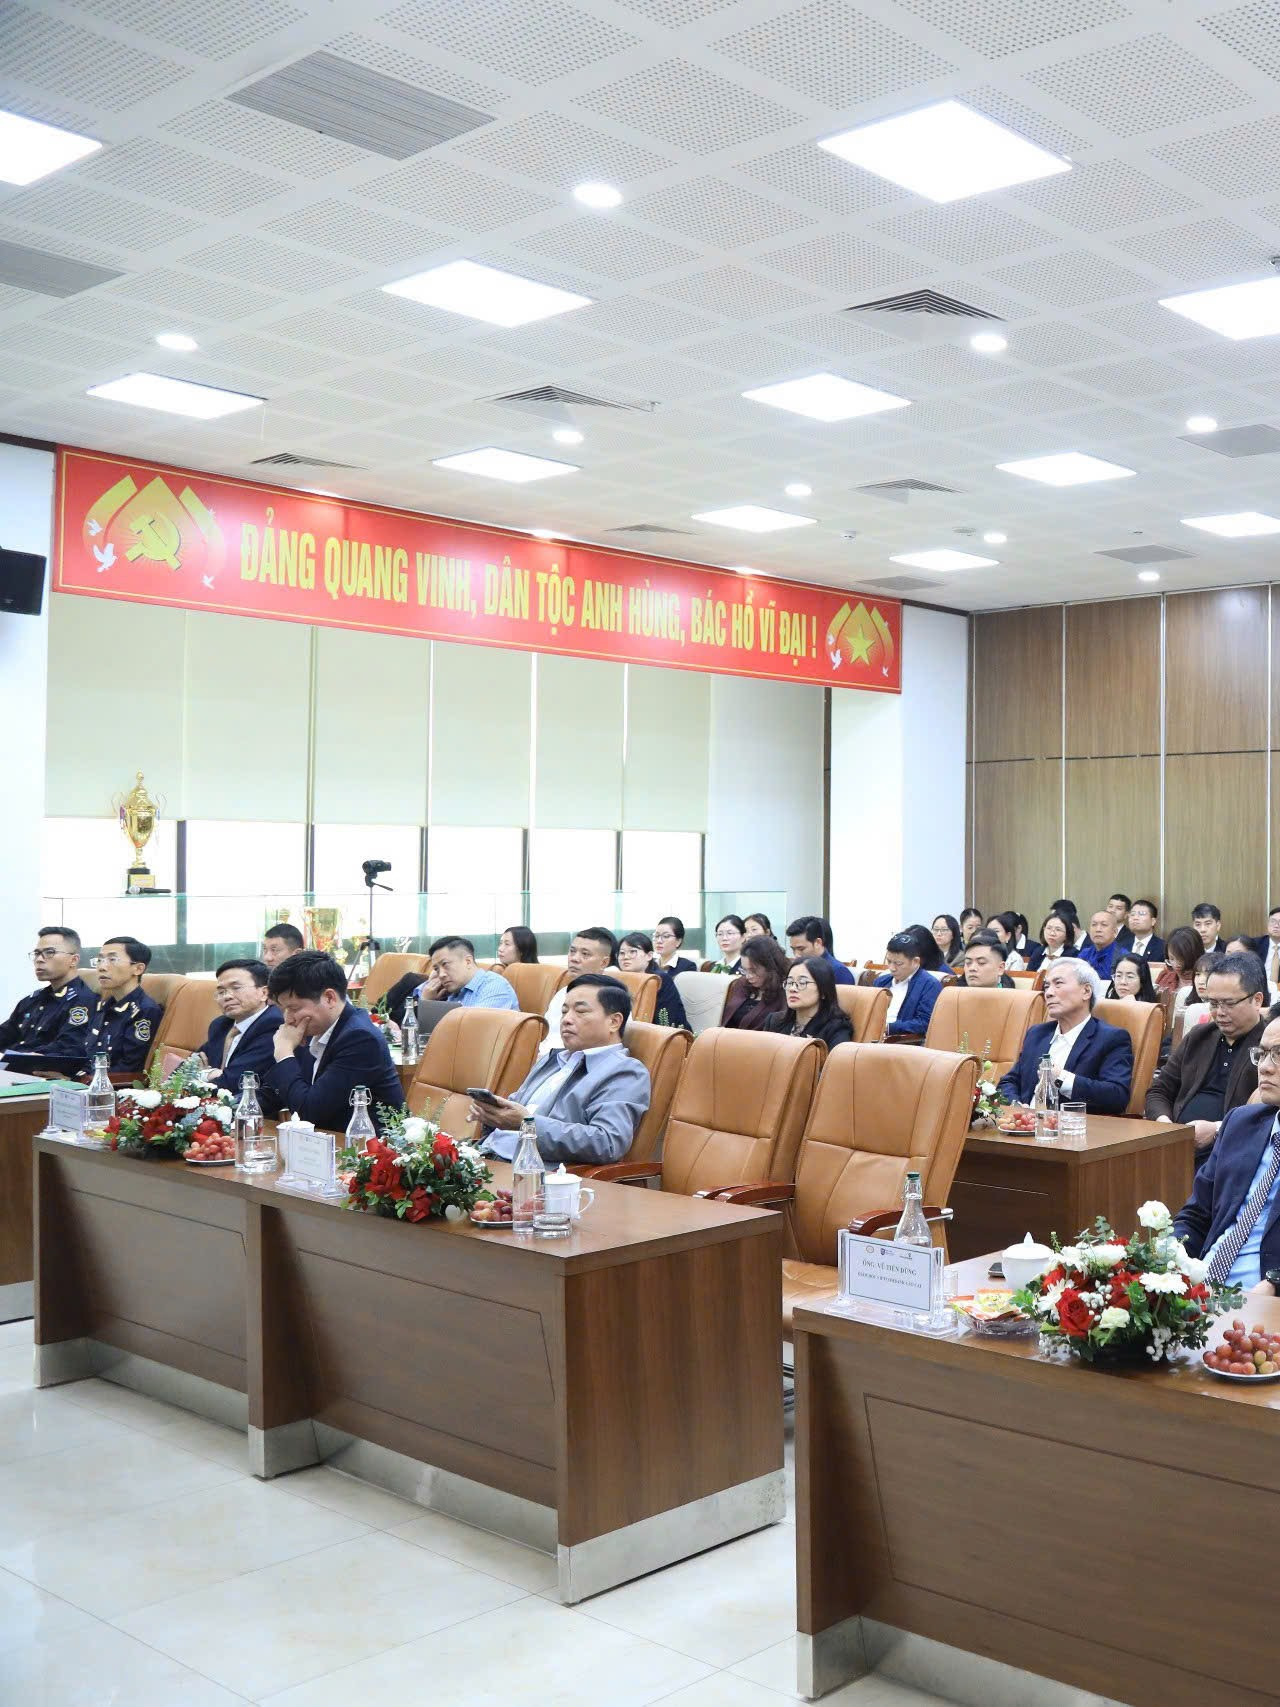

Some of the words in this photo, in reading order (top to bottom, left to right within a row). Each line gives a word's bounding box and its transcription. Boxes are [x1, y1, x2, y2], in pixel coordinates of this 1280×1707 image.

[240, 507, 316, 590] ĐẢNG
[324, 537, 409, 603] QUANG
[416, 552, 477, 619] VINH,
[485, 555, 531, 620] DÂN
[536, 563, 576, 635] TỘC
[581, 579, 623, 633] ANH
[629, 579, 685, 647] HÙNG,
[691, 589, 727, 647] BÁC
[759, 600, 776, 653] VĨ
[779, 610, 807, 667] ĐẠI
